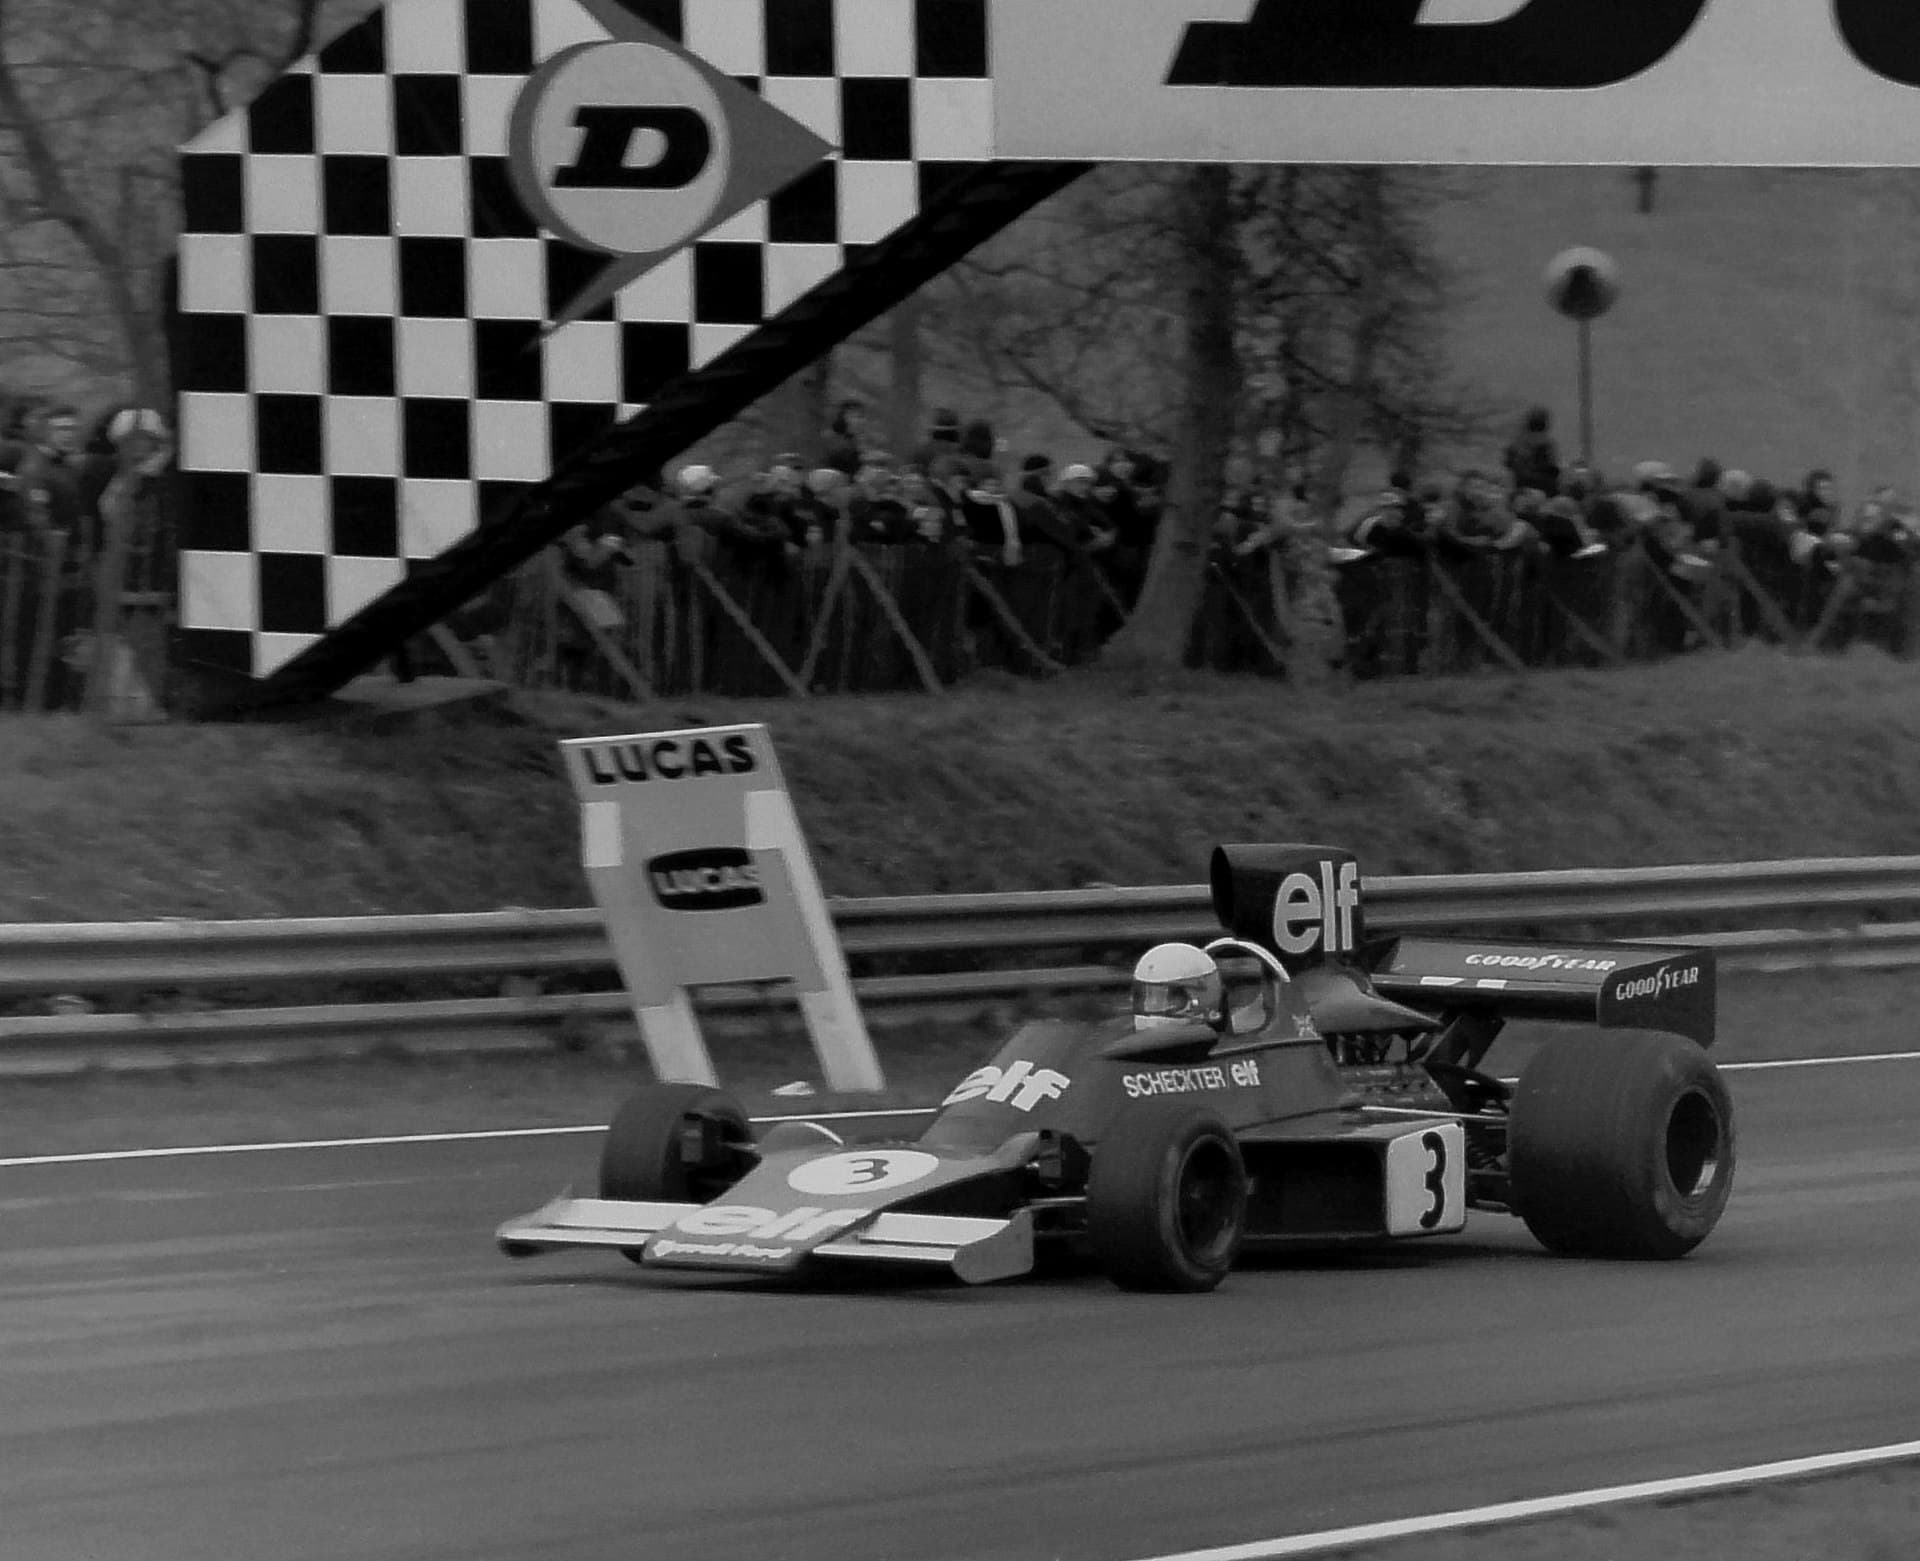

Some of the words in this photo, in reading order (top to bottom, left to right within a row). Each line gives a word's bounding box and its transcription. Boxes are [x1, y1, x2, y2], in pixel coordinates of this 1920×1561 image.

[553, 104, 709, 188] D
[580, 734, 754, 784] LUCAS
[1273, 860, 1358, 954] elf
[1465, 953, 1617, 971] GOODYEAR
[1616, 964, 1699, 1000] GOODYEAR
[942, 1060, 1071, 1112] elf
[1122, 1066, 1226, 1098] SCHECKTER
[1231, 1059, 1261, 1087] elf
[846, 1158, 890, 1185] 3
[1419, 1131, 1446, 1229] 3
[676, 1205, 873, 1241] elf
